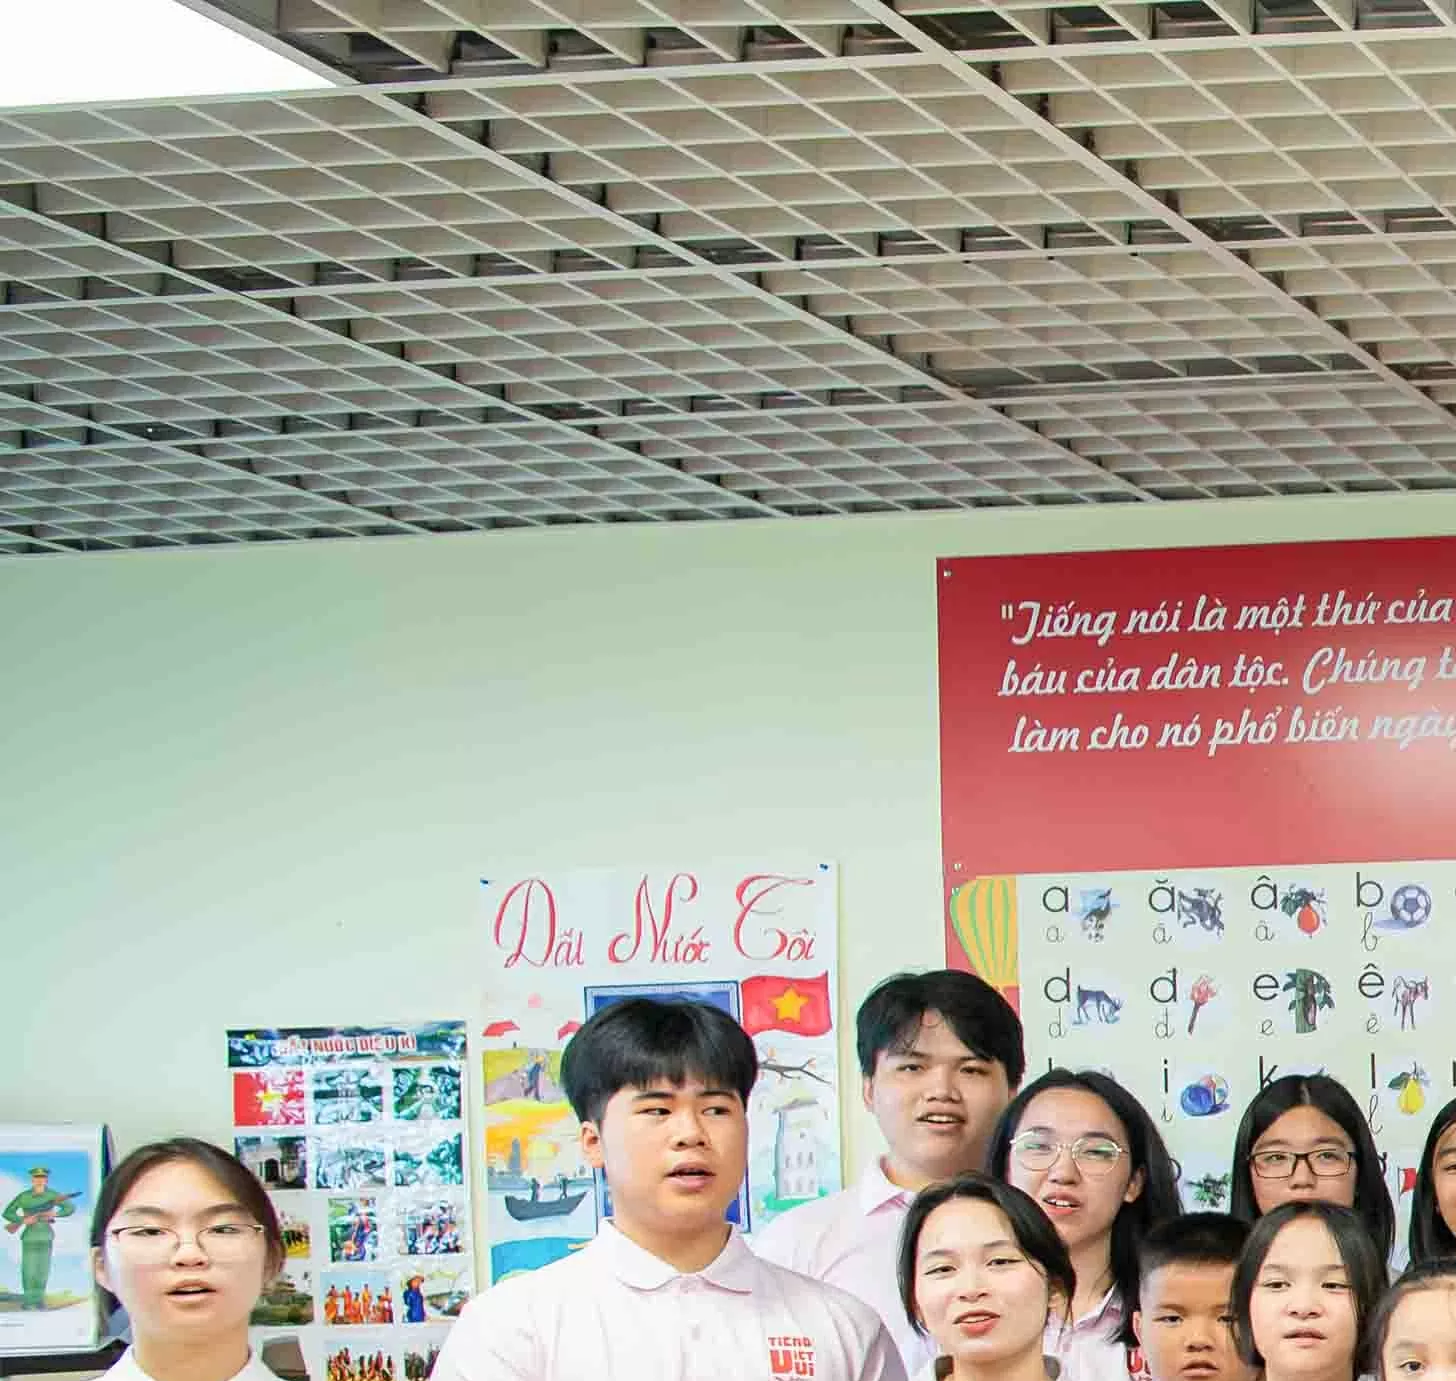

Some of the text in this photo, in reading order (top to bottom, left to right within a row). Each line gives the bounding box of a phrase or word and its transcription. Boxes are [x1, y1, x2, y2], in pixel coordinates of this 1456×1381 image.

[1122, 600, 1184, 635] nói
[1187, 594, 1228, 632] là
[1233, 593, 1307, 636] một
[1312, 588, 1382, 627] thứ
[1384, 588, 1454, 624] của
[997, 659, 1068, 696] báu
[1073, 657, 1142, 696] của
[1146, 652, 1221, 690] dân
[1228, 653, 1288, 694] tộc.
[1302, 646, 1426, 695] Chúng
[1008, 714, 1080, 752] làm
[1086, 712, 1149, 751] cho
[1156, 713, 1201, 748] nó
[1208, 706, 1282, 757] phổ
[1284, 706, 1359, 743] biến
[1043, 886, 1069, 912] a
[1148, 879, 1175, 912] ă
[1251, 875, 1277, 910] â
[1356, 872, 1383, 907] b
[733, 872, 815, 962] Tôi
[1044, 968, 1071, 1003] d
[1150, 968, 1177, 1003] đ
[1253, 974, 1280, 1001] e
[1358, 963, 1384, 998] ê
[1164, 1059, 1168, 1094] i
[1371, 1053, 1376, 1089] l
